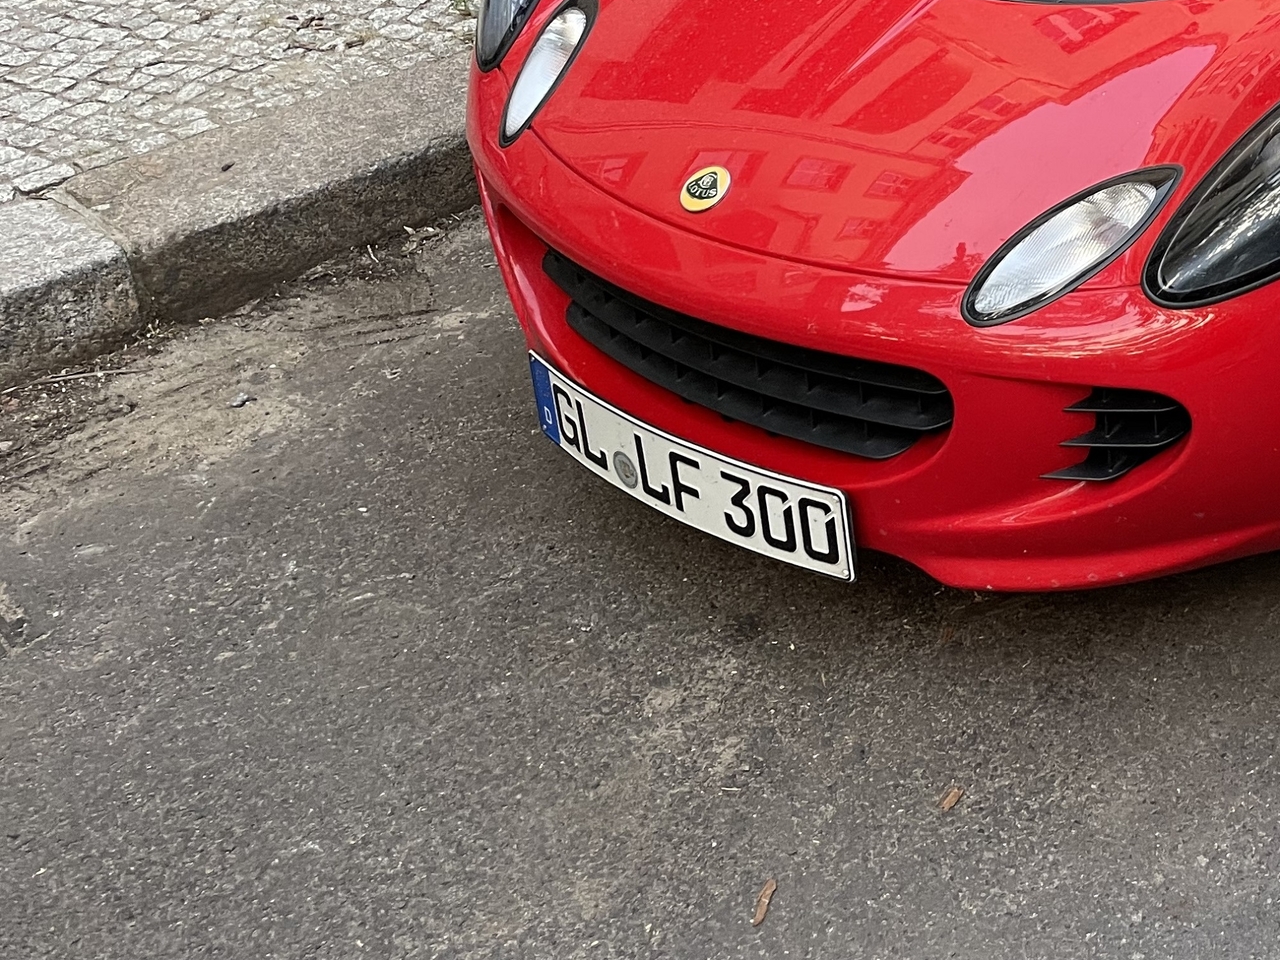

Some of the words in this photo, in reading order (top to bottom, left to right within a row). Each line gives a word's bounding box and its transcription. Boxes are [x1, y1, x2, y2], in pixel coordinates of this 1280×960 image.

[688, 181, 717, 197] LOTUS
[544, 406, 553, 425] D
[552, 381, 609, 472] GL
[633, 431, 700, 513] LF
[719, 470, 840, 565] 300
